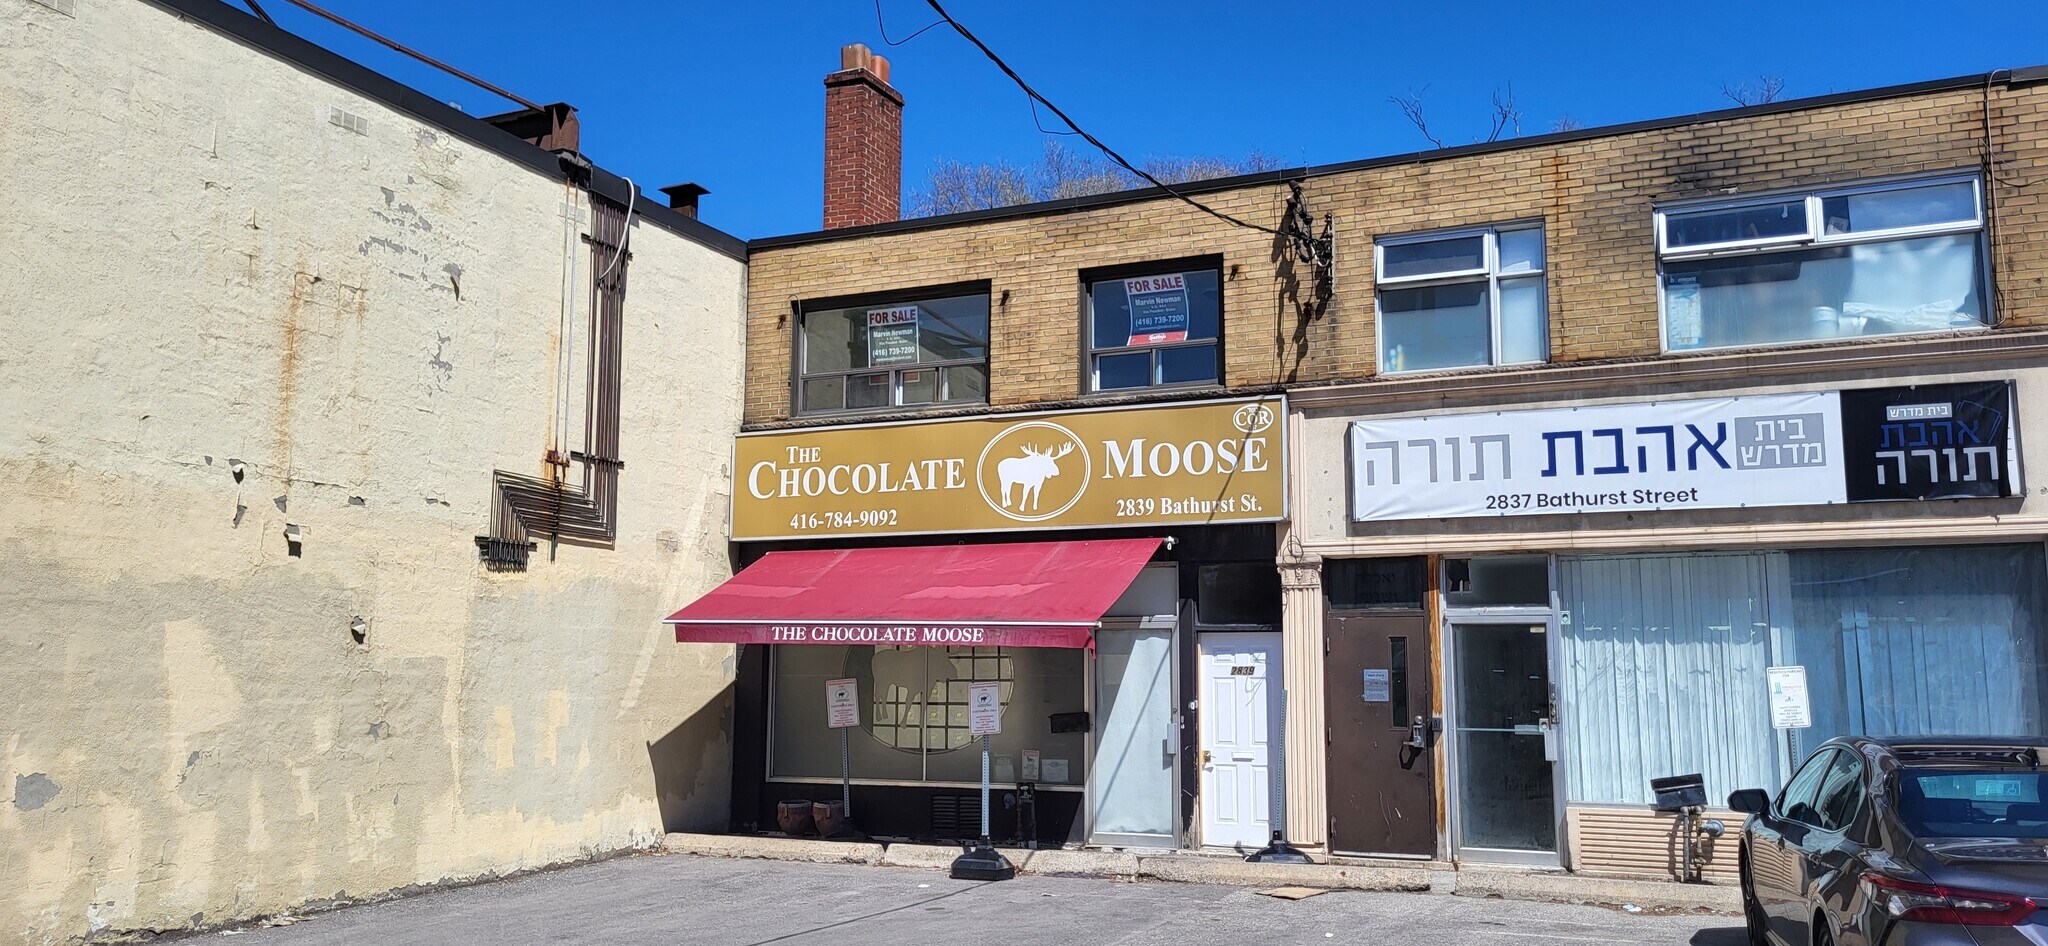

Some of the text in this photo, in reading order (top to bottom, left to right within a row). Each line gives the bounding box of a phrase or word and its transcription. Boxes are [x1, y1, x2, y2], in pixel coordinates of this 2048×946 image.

[1127, 276, 1183, 293] FOR SALE
[1135, 296, 1181, 306] Marvin Newman
[869, 309, 916, 325] FOR SALE
[1135, 314, 1184, 327] (416) 739-7200
[873, 330, 890, 338] Marvin
[872, 349, 888, 358] (416)
[889, 346, 915, 355] 739-7200
[1235, 410, 1271, 426] COR
[1889, 405, 1949, 418] בית מדרש
[1754, 418, 1806, 442] בית
[1880, 420, 1982, 448] אהבת
[786, 445, 821, 465] THE
[1365, 422, 1732, 486] אהבת תורה
[1740, 442, 1823, 467] מדרש
[748, 437, 1268, 499] CHOCOLATE MOOSE
[1875, 446, 1999, 485] תורה
[1116, 493, 1262, 517] 2839 Bathurst St.
[1485, 487, 1698, 510] 2837 Bathurst Street
[789, 508, 897, 529] 416-784-9092
[771, 626, 984, 643] THE CHOCOLATE MOOSE
[1231, 666, 1255, 675] 2839
